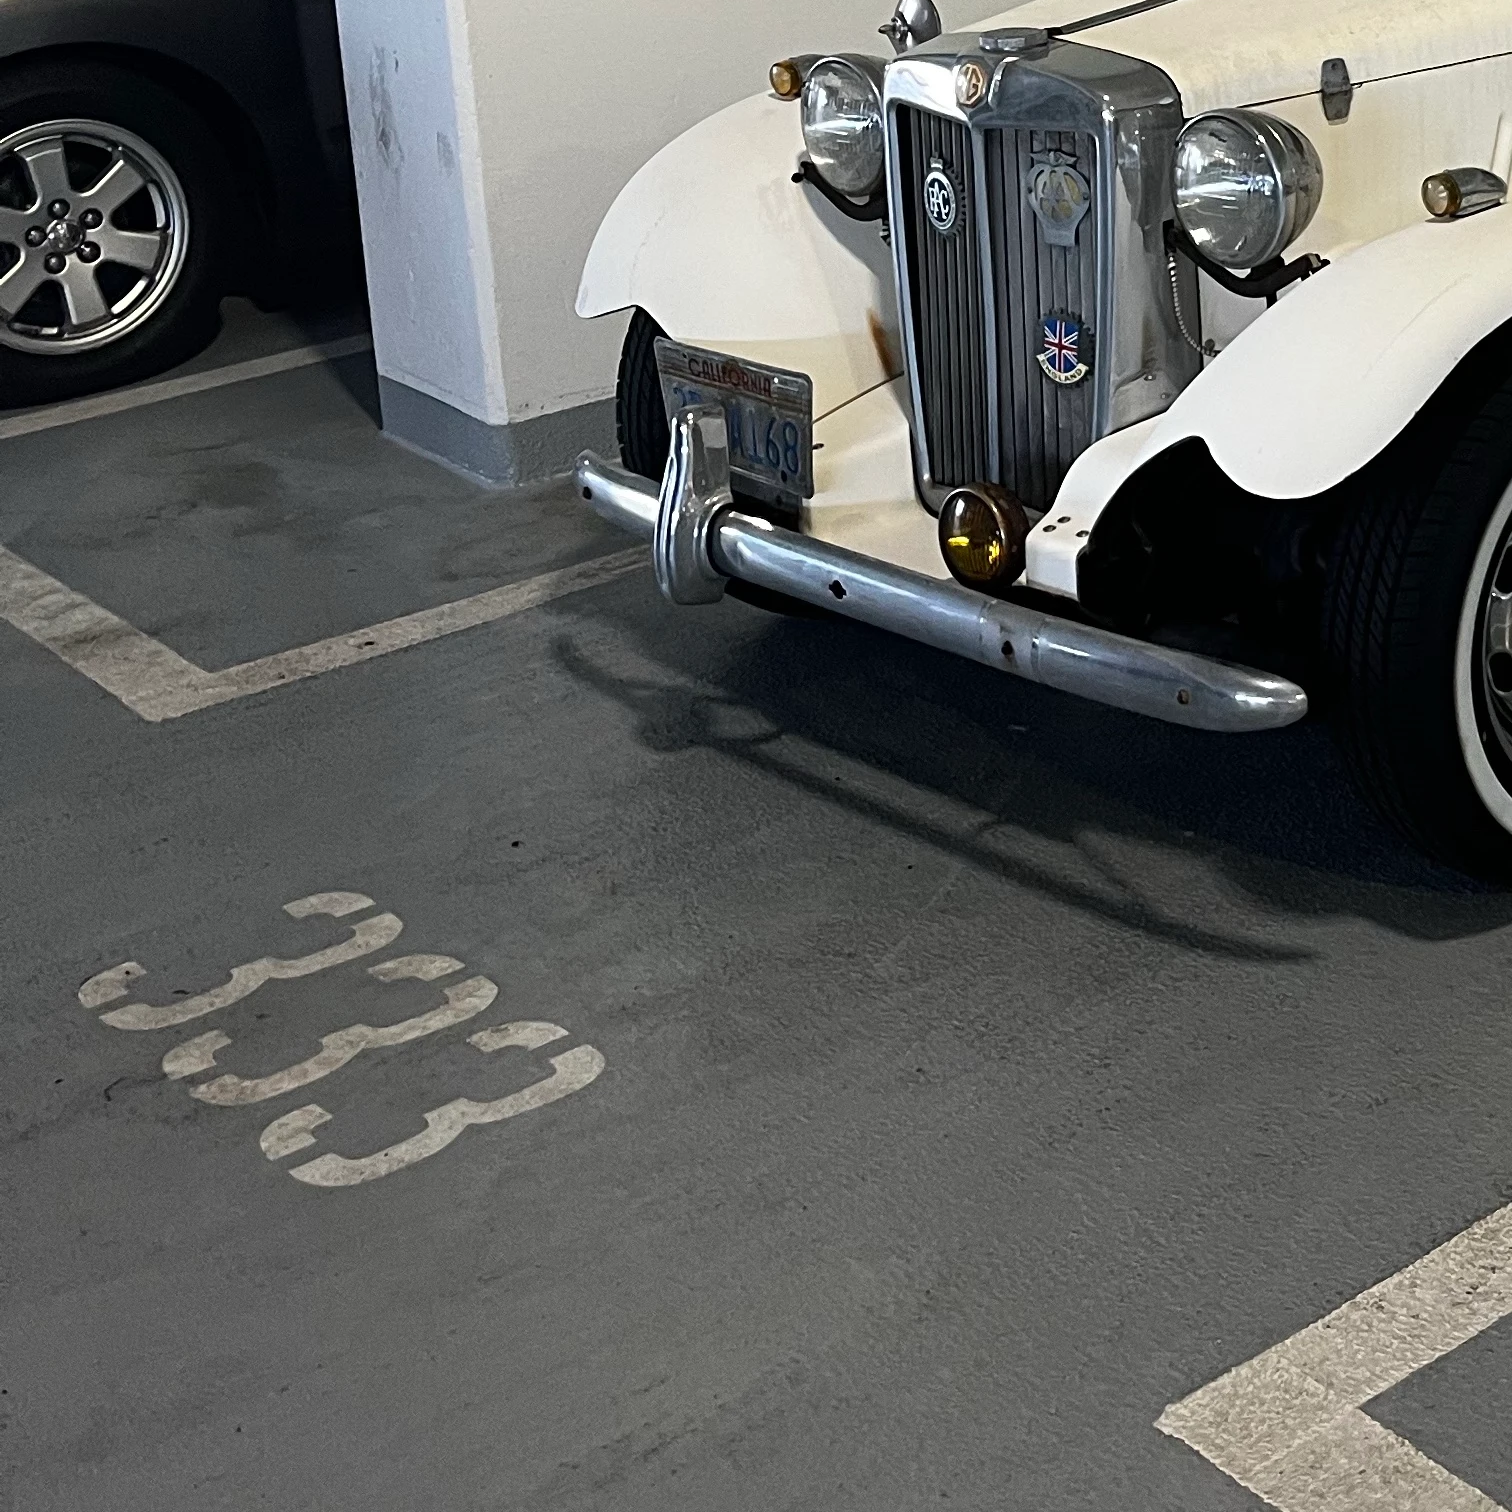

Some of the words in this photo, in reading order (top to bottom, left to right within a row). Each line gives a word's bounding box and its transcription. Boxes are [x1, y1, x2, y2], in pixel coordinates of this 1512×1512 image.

[929, 181, 949, 219] RAC
[688, 357, 772, 399] CALIFORNIA
[1041, 358, 1083, 382] ENGLAND
[78, 891, 606, 1187] 333
